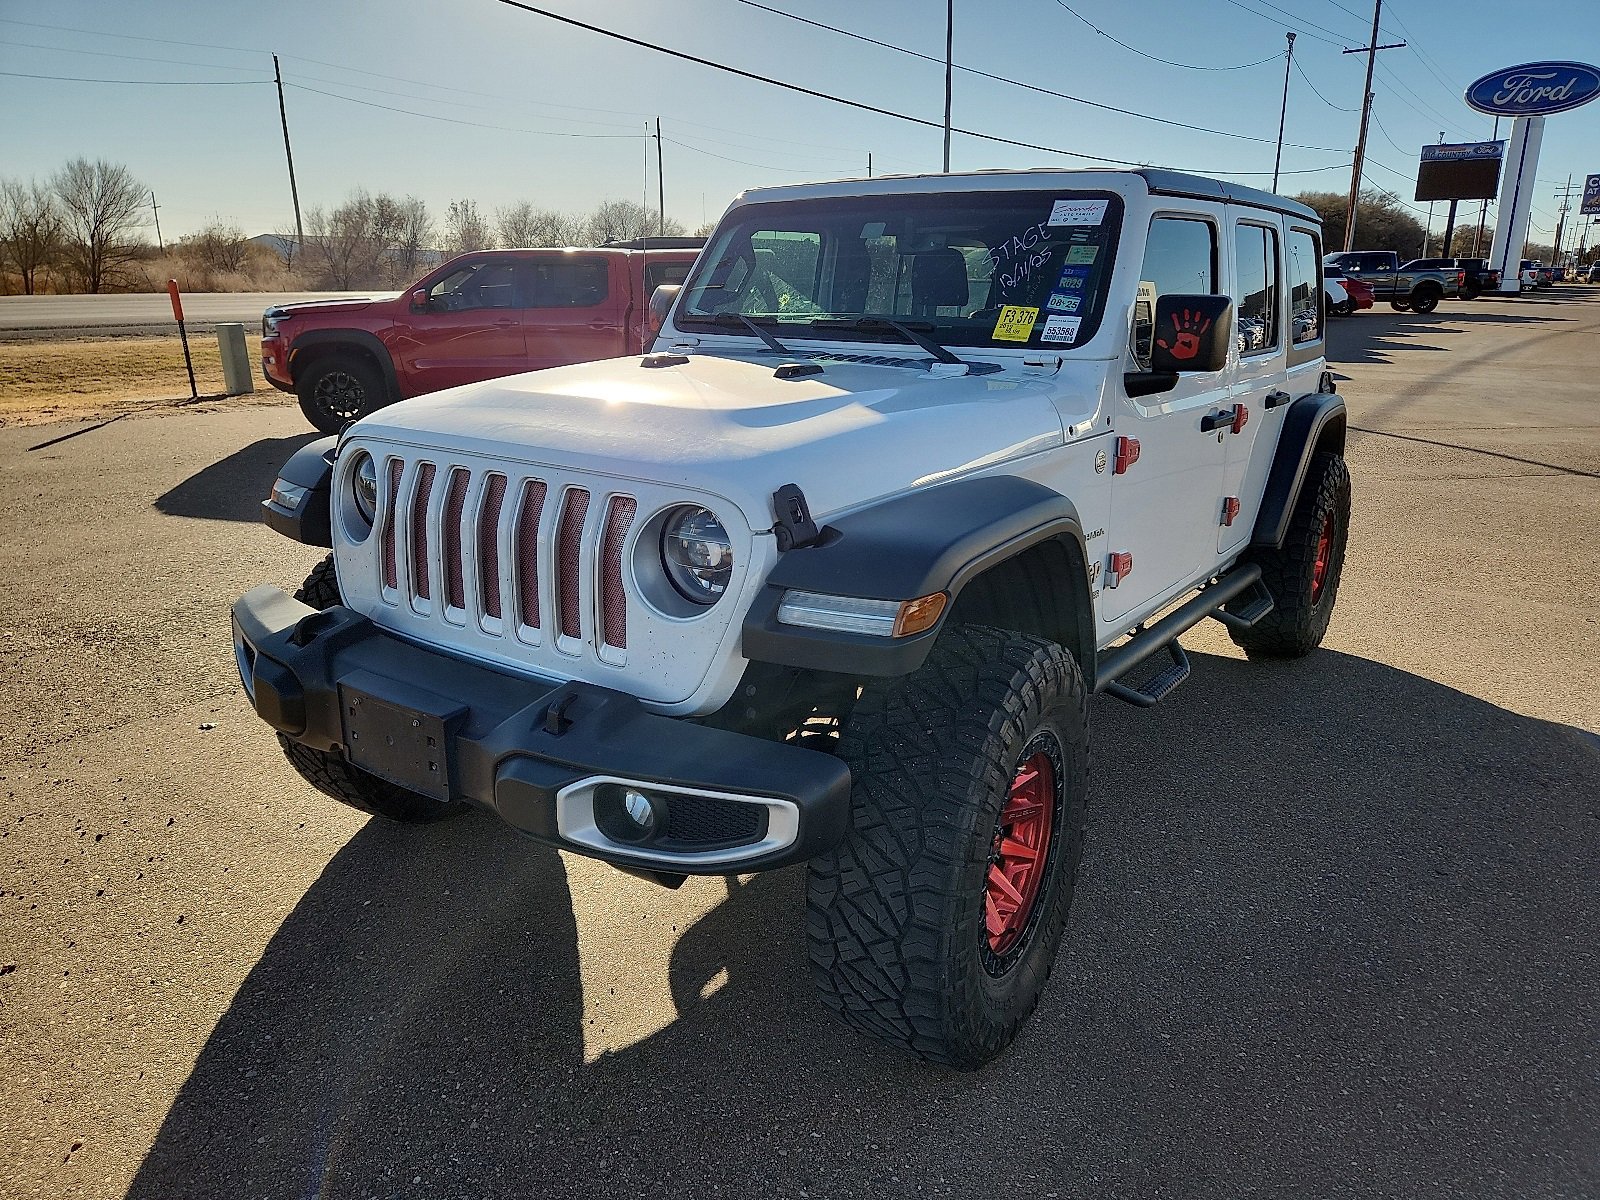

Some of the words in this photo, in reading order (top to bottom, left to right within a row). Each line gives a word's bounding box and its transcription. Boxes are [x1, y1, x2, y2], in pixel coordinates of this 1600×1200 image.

[1493, 73, 1578, 105] Ford
[1589, 177, 1600, 187] C
[981, 221, 1052, 279] STAGE
[1003, 309, 1017, 323] F3
[1017, 310, 1036, 325] 376
